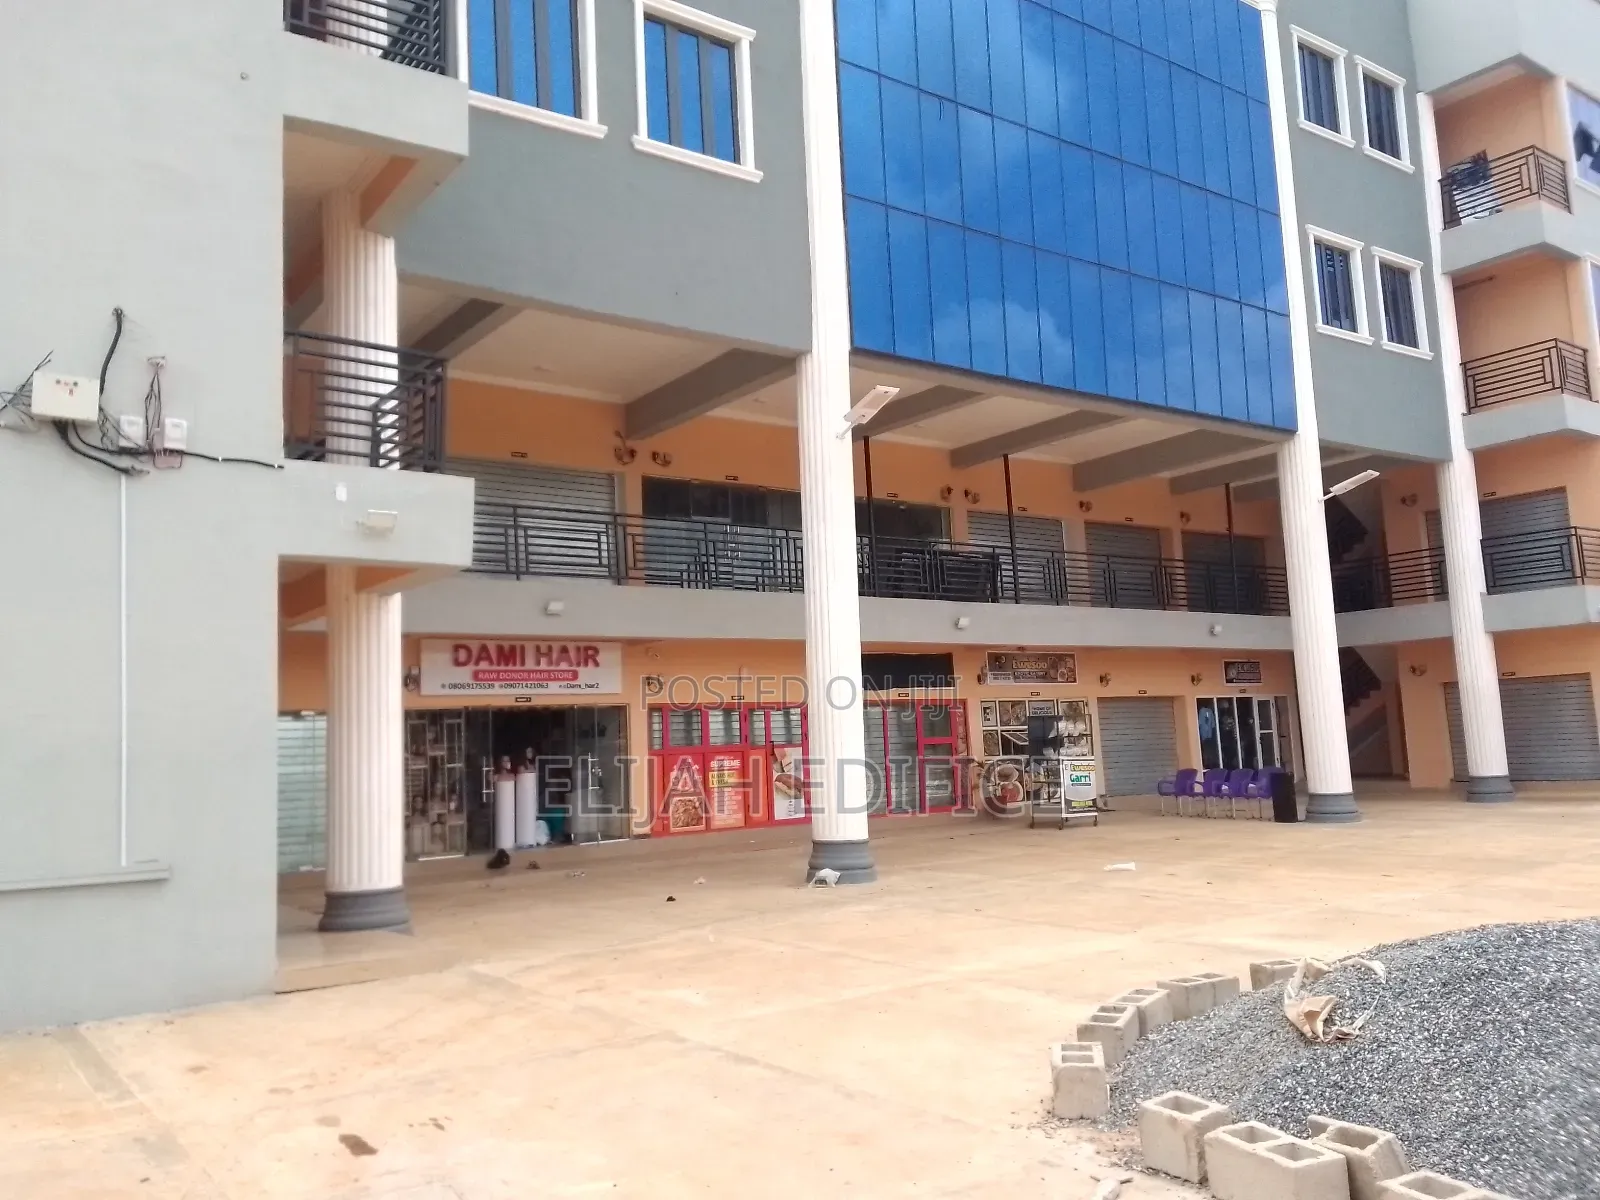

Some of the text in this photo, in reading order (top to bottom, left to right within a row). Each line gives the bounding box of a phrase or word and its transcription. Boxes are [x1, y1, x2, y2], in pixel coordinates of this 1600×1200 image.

[452, 643, 600, 668] DAMI HAIR
[478, 671, 573, 680] RAW DONOR HAIR STORE
[1070, 772, 1091, 783] Garri
